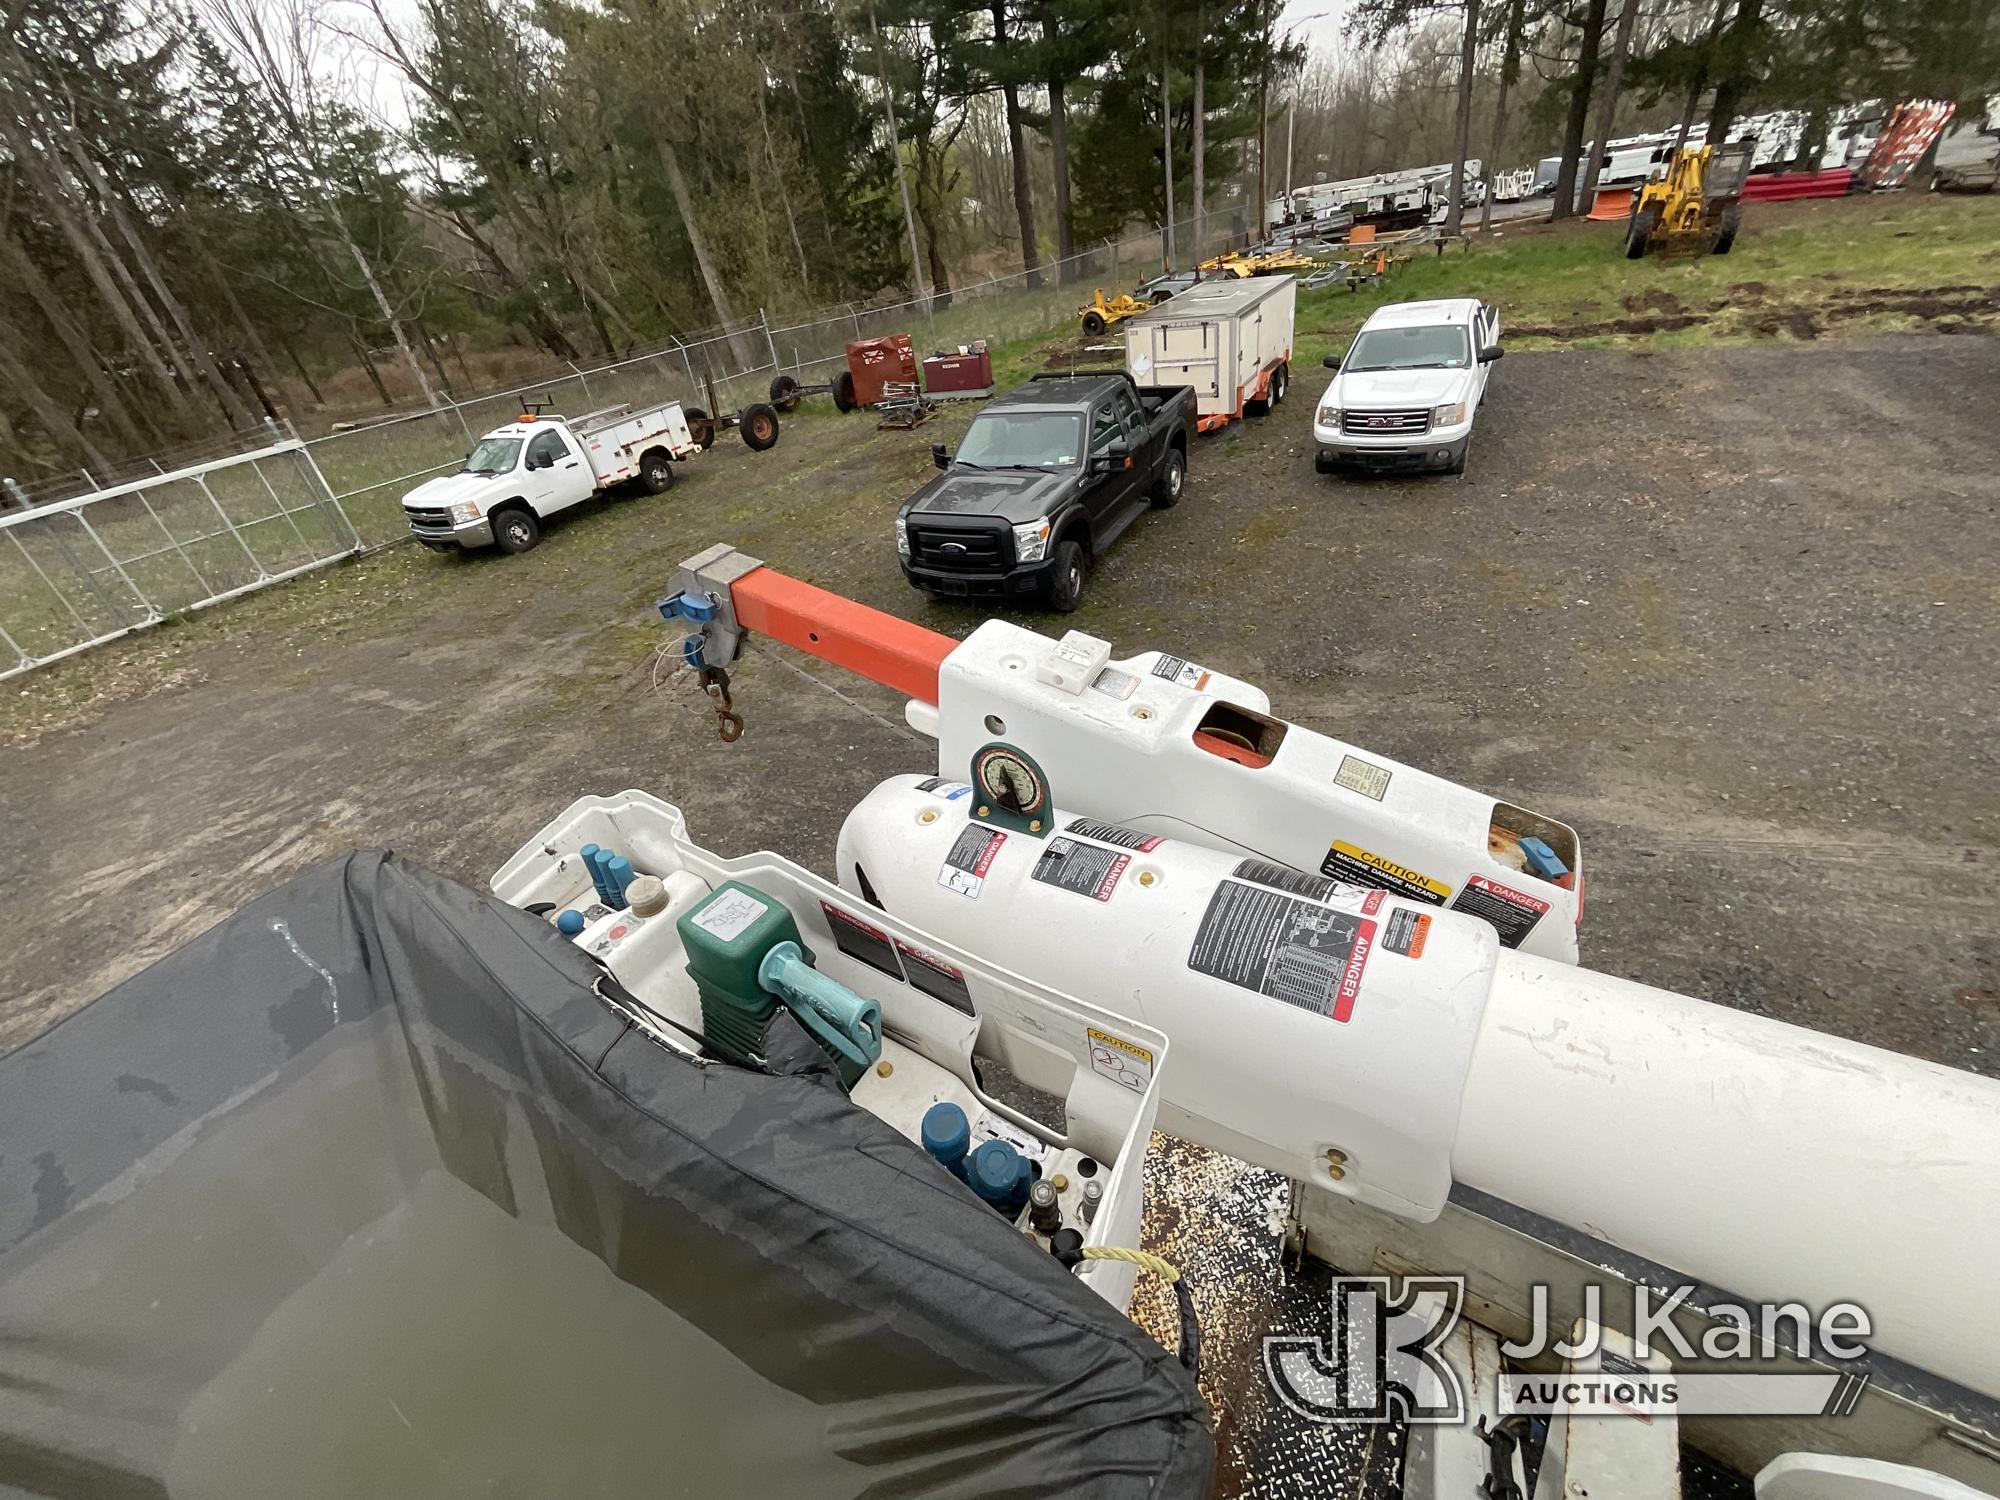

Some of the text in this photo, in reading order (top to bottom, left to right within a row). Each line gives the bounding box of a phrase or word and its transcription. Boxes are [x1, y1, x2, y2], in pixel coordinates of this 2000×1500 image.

[1367, 417, 1404, 428] GMC
[979, 841, 1002, 873] DANGER
[1360, 852, 1430, 886] CAUTION
[1098, 861, 1125, 900] DANGER
[1335, 852, 1438, 900] MACHINE DAMAGE HAZARD
[1475, 888, 1507, 903] ELECTRICAL
[1493, 885, 1543, 910] DANGER
[1412, 921, 1428, 953] WARNING
[1341, 944, 1368, 998] DANGER
[1094, 1032, 1145, 1057] CAUTION
